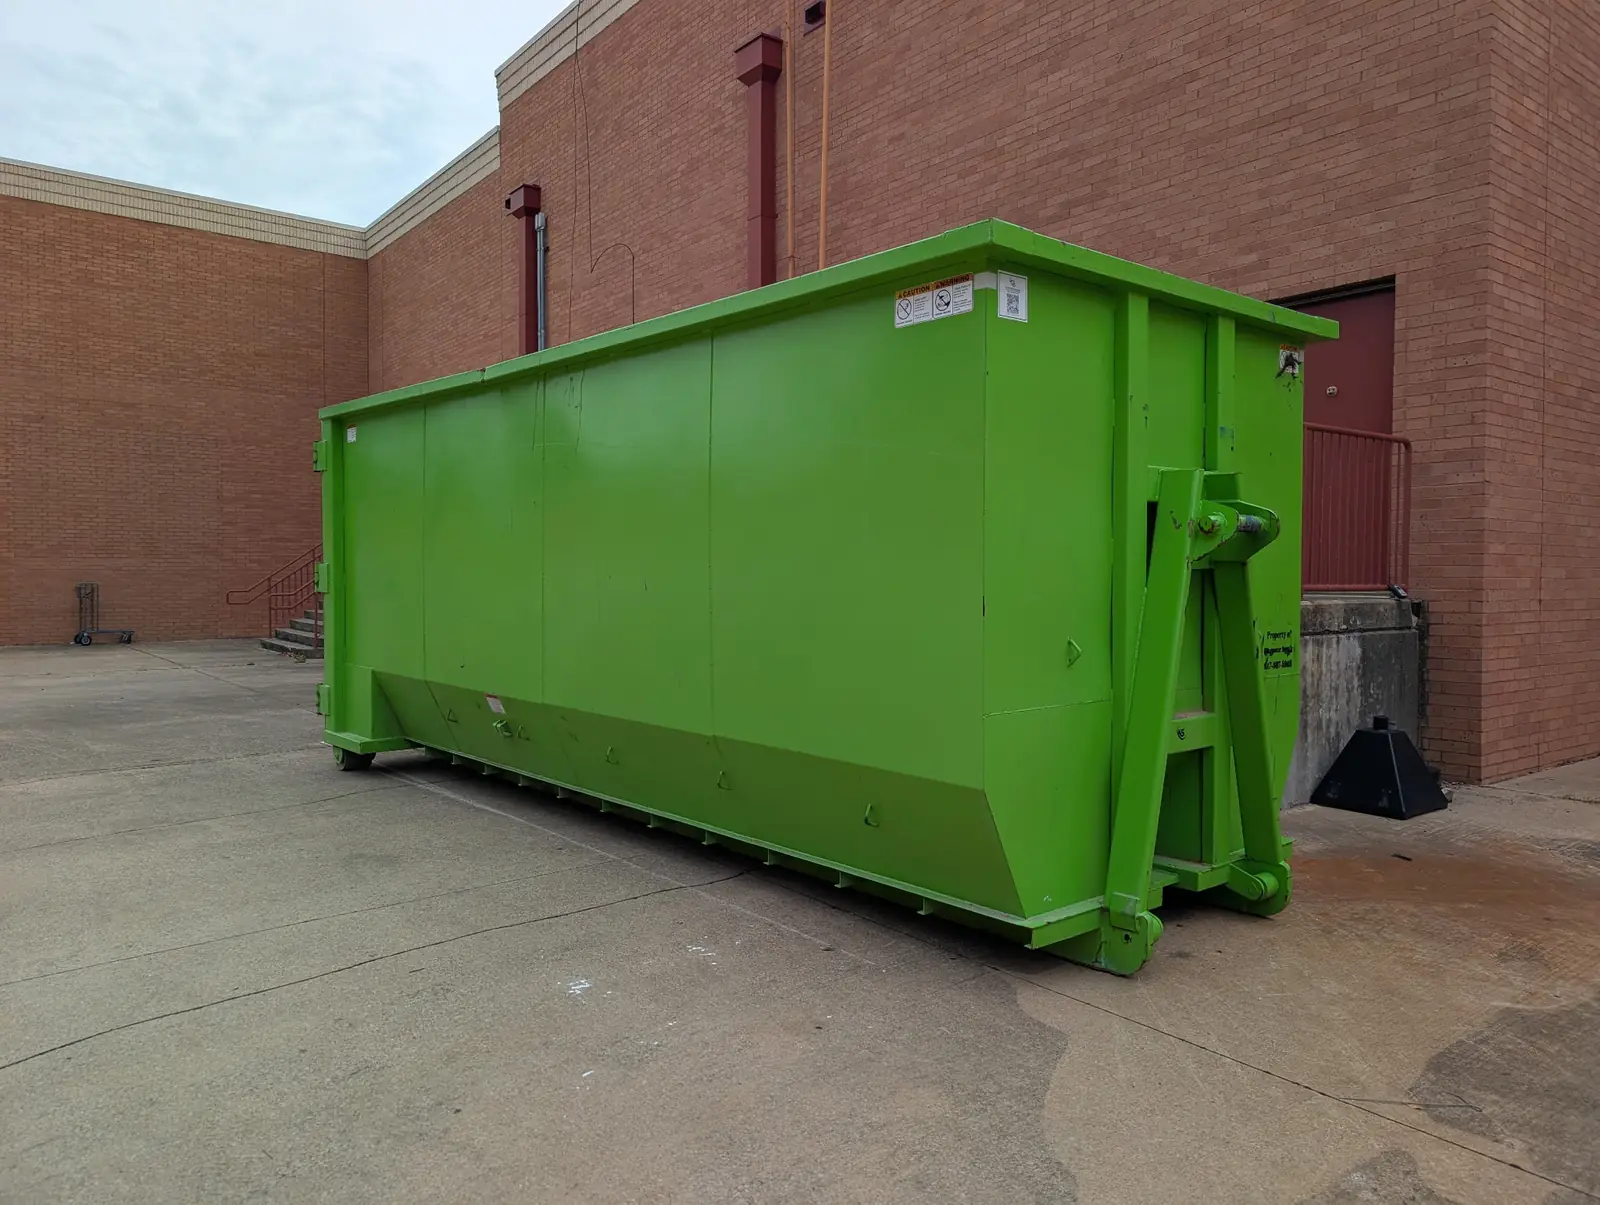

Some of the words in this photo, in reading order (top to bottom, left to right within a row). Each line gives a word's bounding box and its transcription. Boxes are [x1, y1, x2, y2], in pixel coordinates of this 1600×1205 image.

[940, 274, 969, 287] WARNING
[903, 285, 930, 297] CAUTION
[1267, 631, 1286, 641] Property
